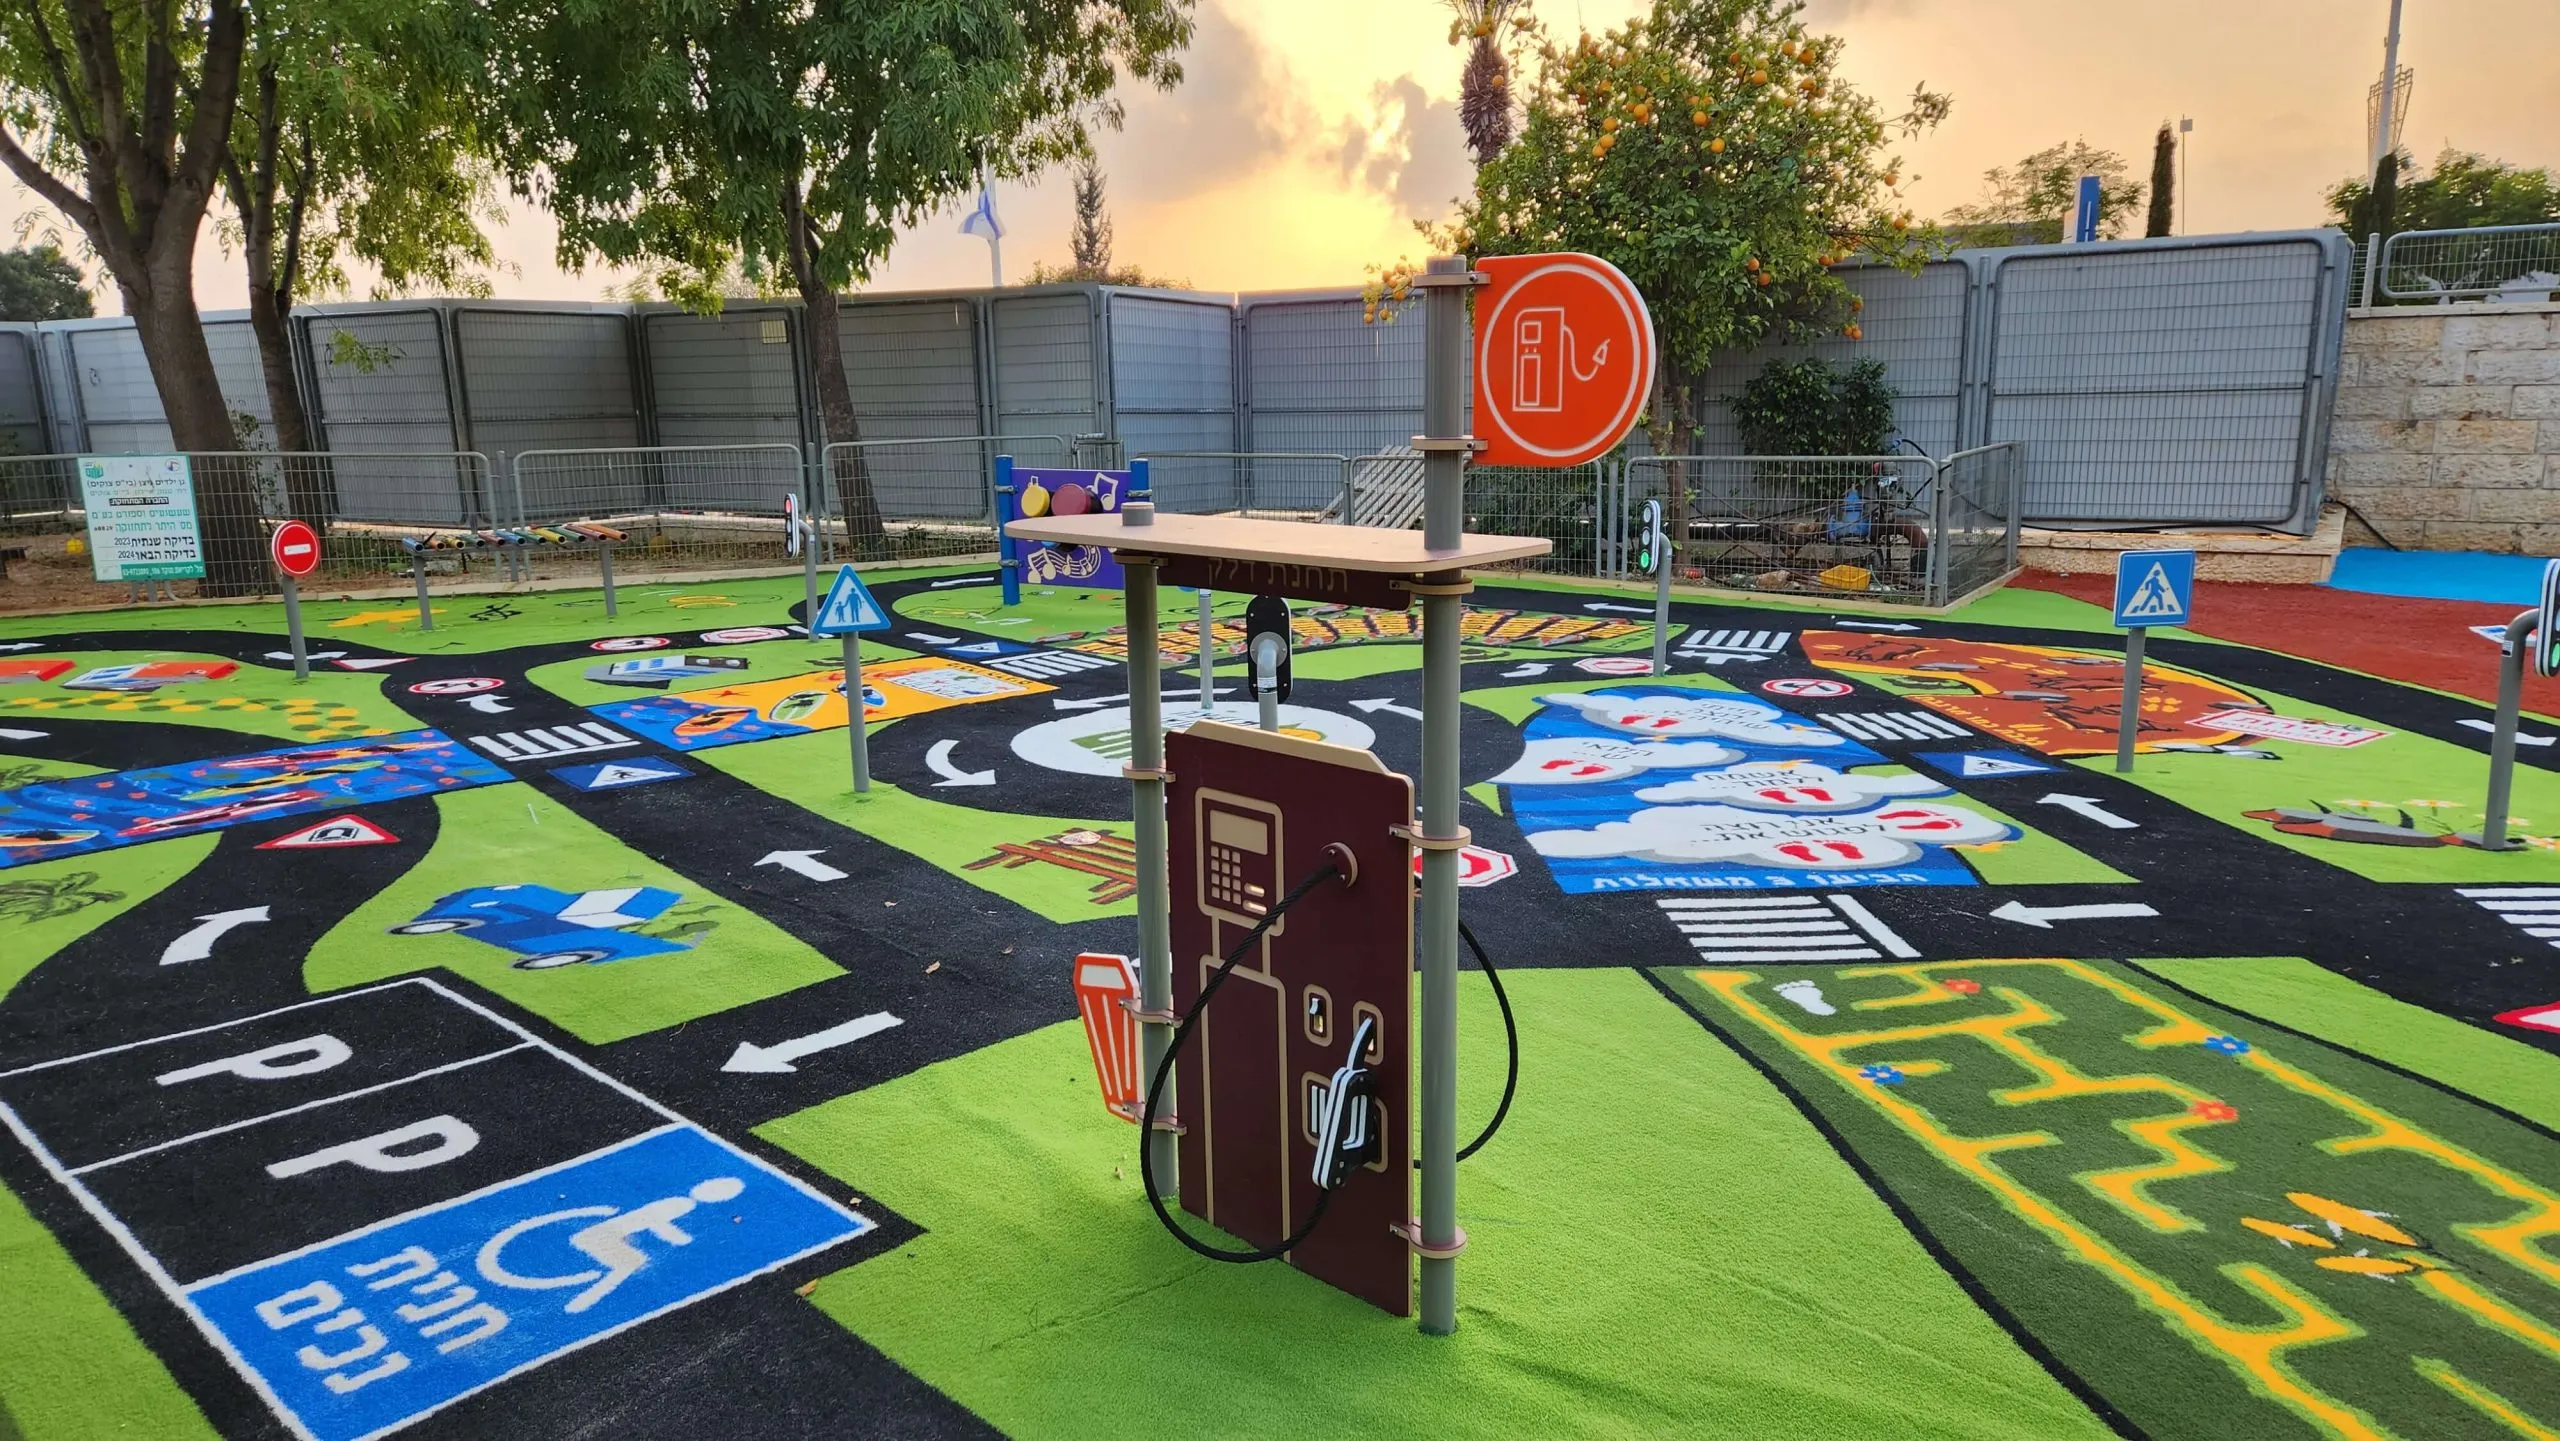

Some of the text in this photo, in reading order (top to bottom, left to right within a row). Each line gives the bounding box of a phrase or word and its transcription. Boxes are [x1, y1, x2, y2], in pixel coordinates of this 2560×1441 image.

[155, 478, 177, 486] ילדים
[114, 536, 195, 548] בדיקה שנתית 2023
[118, 551, 134, 559] 2024
[164, 549, 196, 561] בדיקה
[1208, 557, 1348, 592] תחנת דלק
[1703, 769, 1803, 781] אשמח
[1700, 817, 1845, 831] אני רוצה
[1780, 823, 1887, 838] לפגוש
[1592, 873, 1757, 889] משאלות
[1806, 871, 1929, 887] הביעו
[155, 1033, 353, 1086] P
[264, 1114, 480, 1179] P
[346, 1245, 511, 1355] חנית
[254, 1280, 412, 1394] נכים
